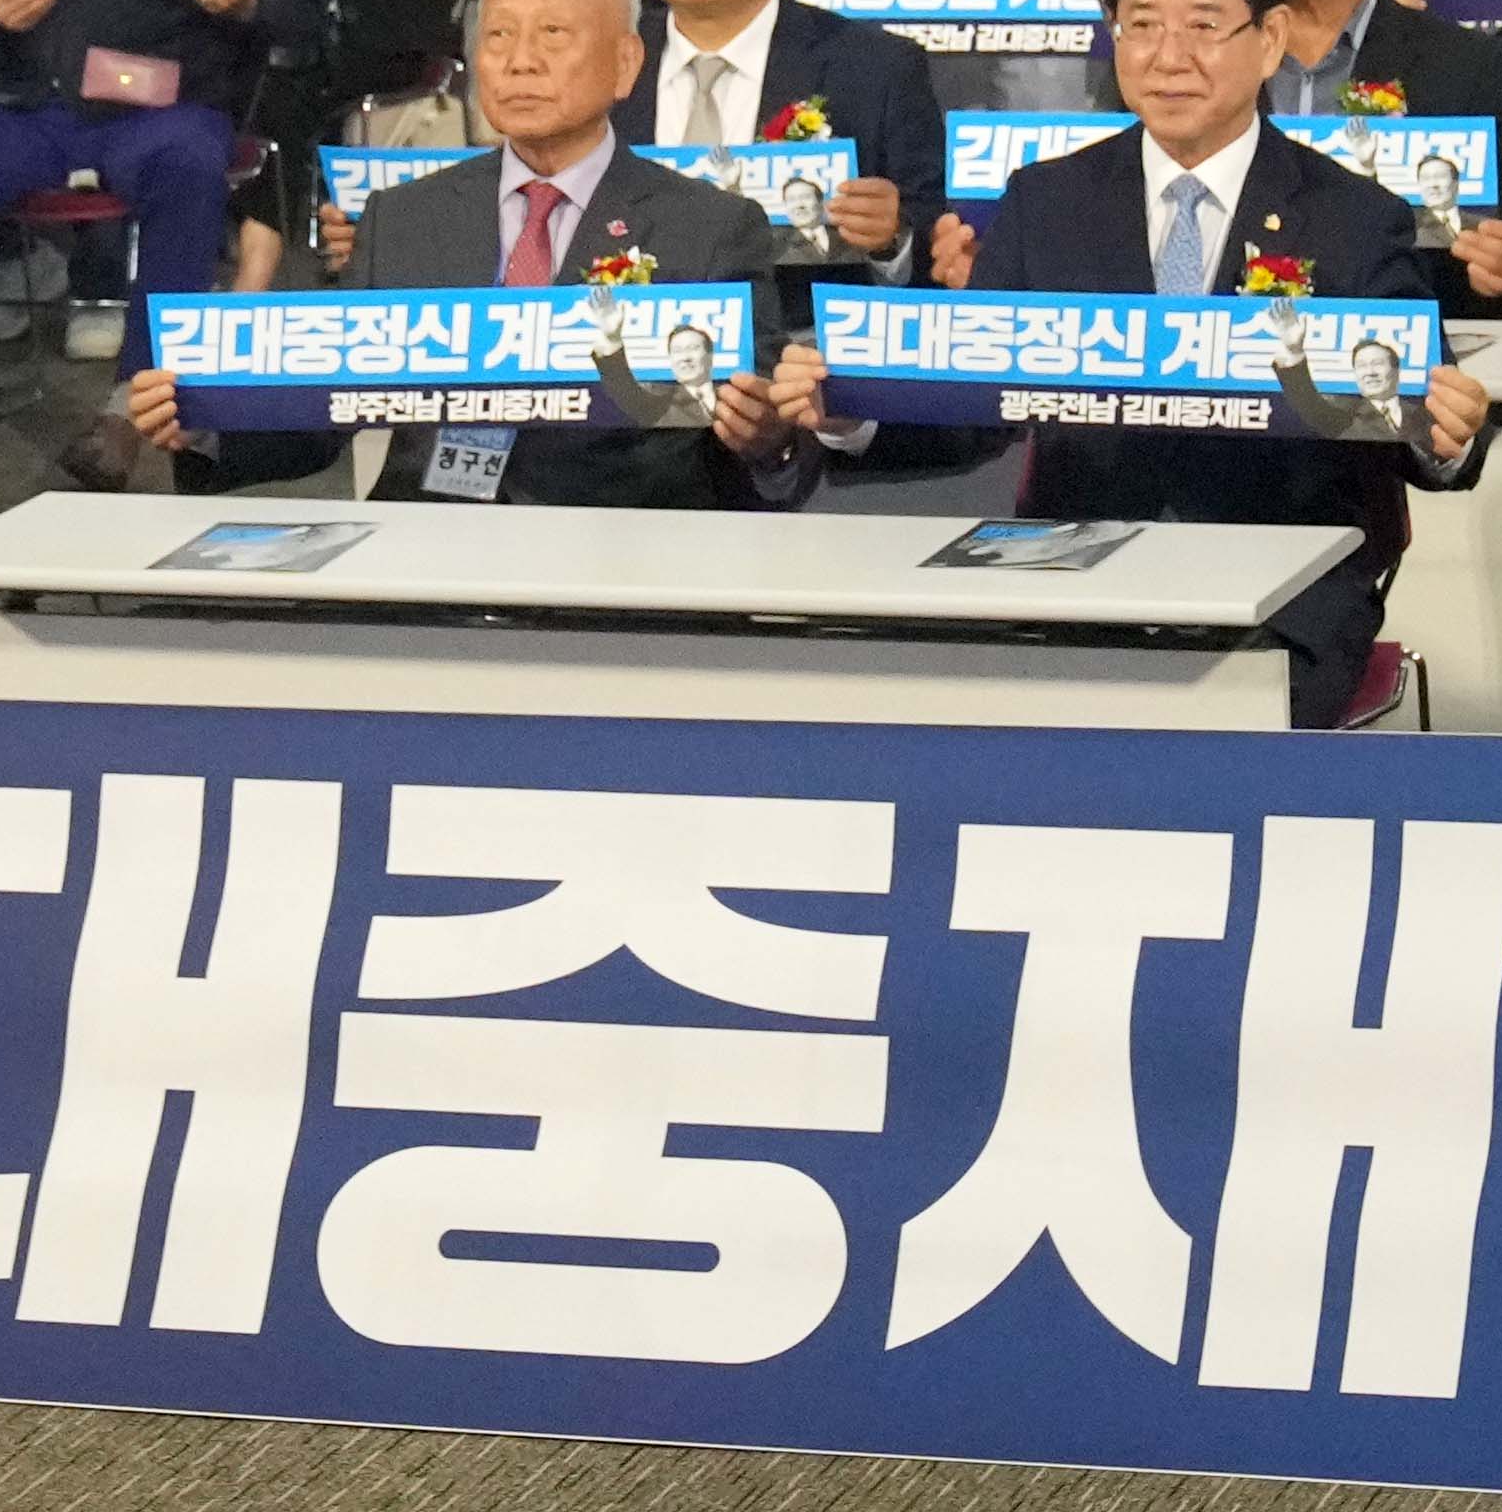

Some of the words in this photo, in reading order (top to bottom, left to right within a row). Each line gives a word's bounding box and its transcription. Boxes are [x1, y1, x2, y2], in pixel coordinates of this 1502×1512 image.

[977, 24, 1093, 51] 김대중재단
[161, 303, 473, 375] 김대중정신
[487, 298, 741, 367] 계승발전
[824, 299, 1146, 376] 김대중정신
[1161, 309, 1430, 383] 계승발전
[330, 391, 445, 422] 광주전남
[447, 389, 591, 422] 김대중재단
[1001, 391, 1119, 424] 광주전남
[1121, 395, 1271, 429] 김대중재단
